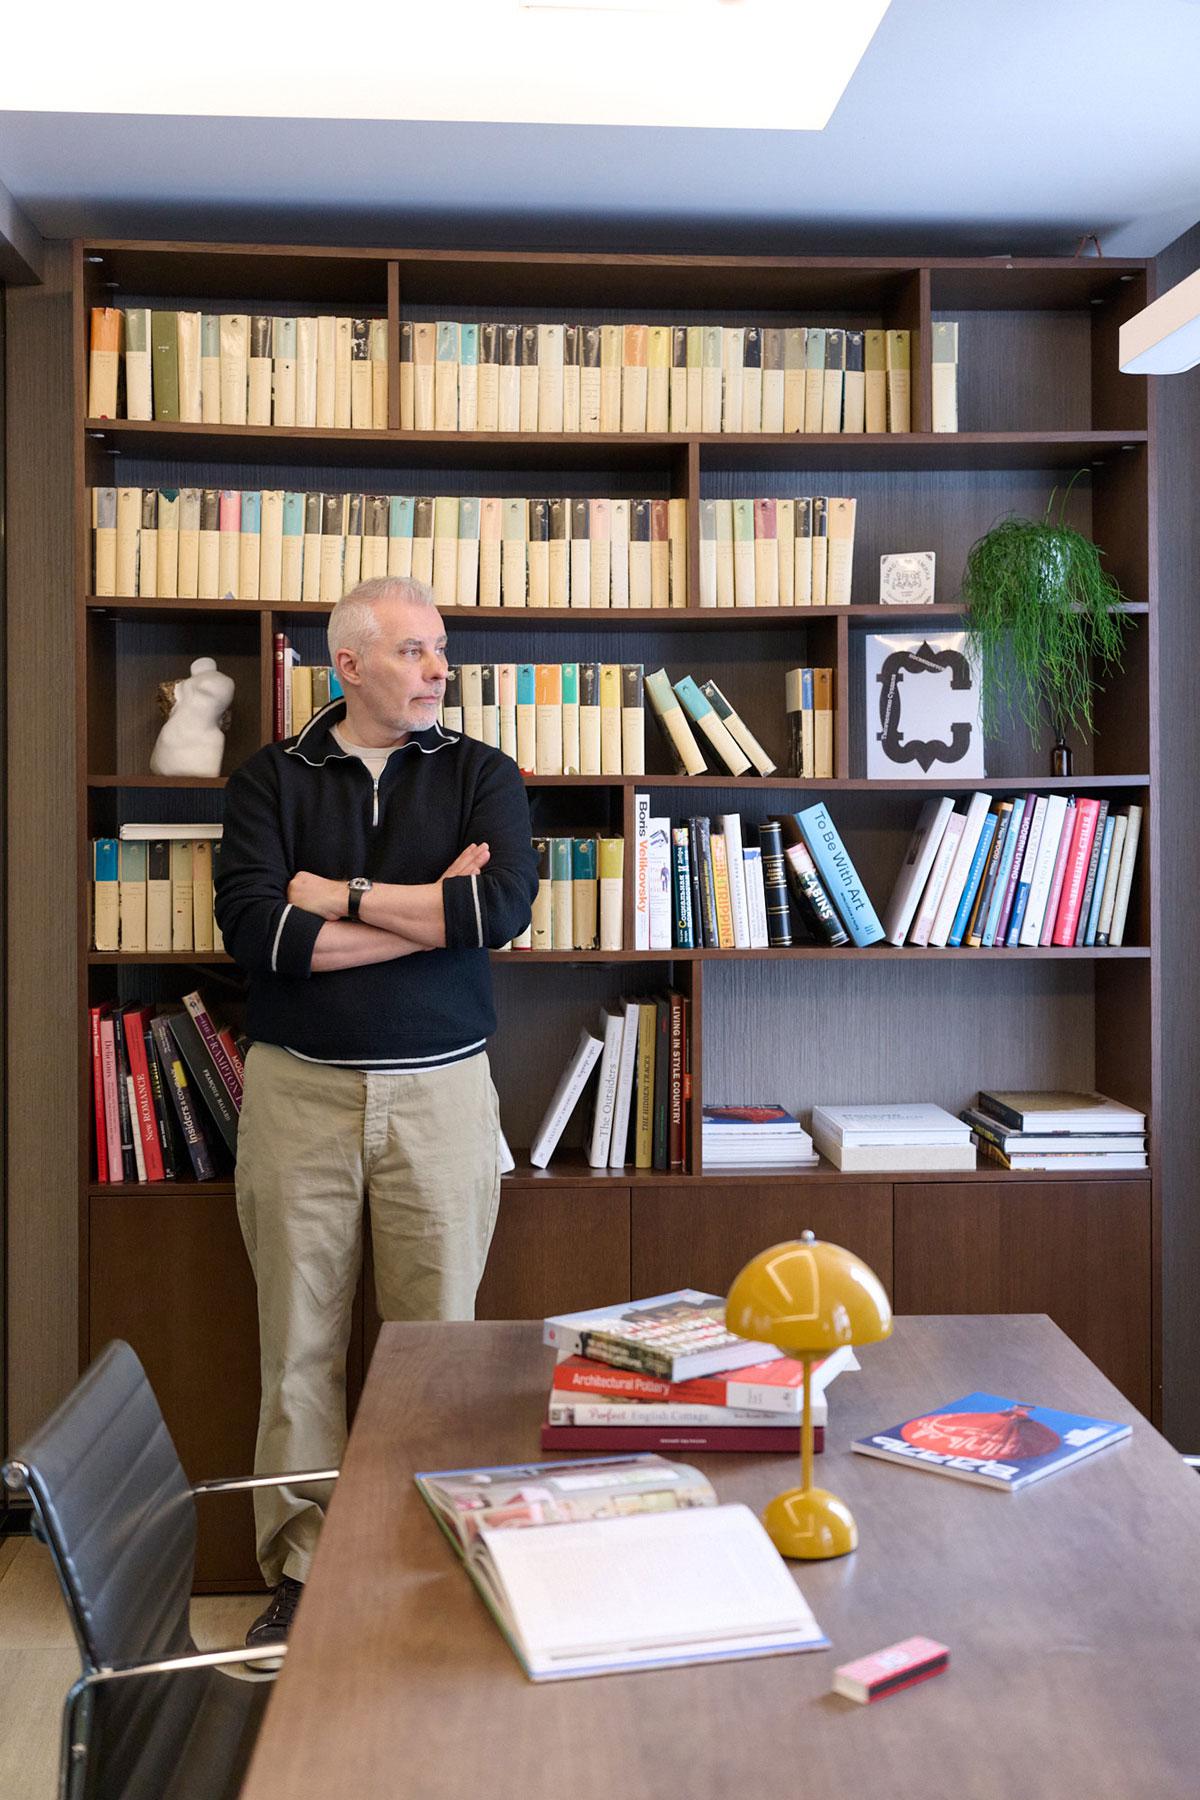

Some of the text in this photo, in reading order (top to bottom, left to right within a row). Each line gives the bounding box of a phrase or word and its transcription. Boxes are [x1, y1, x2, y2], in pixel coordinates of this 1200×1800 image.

[1100, 805, 1108, 819] THE
[1019, 815, 1031, 852] MODERN
[1079, 816, 1091, 849] СТИЛЯ
[1096, 820, 1105, 841] ARTS
[638, 801, 647, 912] Boris Velikovsky
[813, 810, 827, 830] To
[822, 831, 837, 852] Be
[832, 852, 853, 886] With
[849, 888, 866, 911] Art
[993, 839, 1002, 859] WOOD
[1012, 852, 1023, 880] LIVING
[804, 871, 832, 920] CABINS
[231, 1055, 245, 1080] MODE
[672, 1005, 680, 1123] LIVING IN STYLE COUNTRY
[136, 1073, 154, 1141] New ROMANCE
[600, 1063, 616, 1137] The Outsiders
[181, 1104, 198, 1144] Insiders
[572, 1373, 671, 1396] Architectural Pottery
[589, 1406, 627, 1421] Perfect
